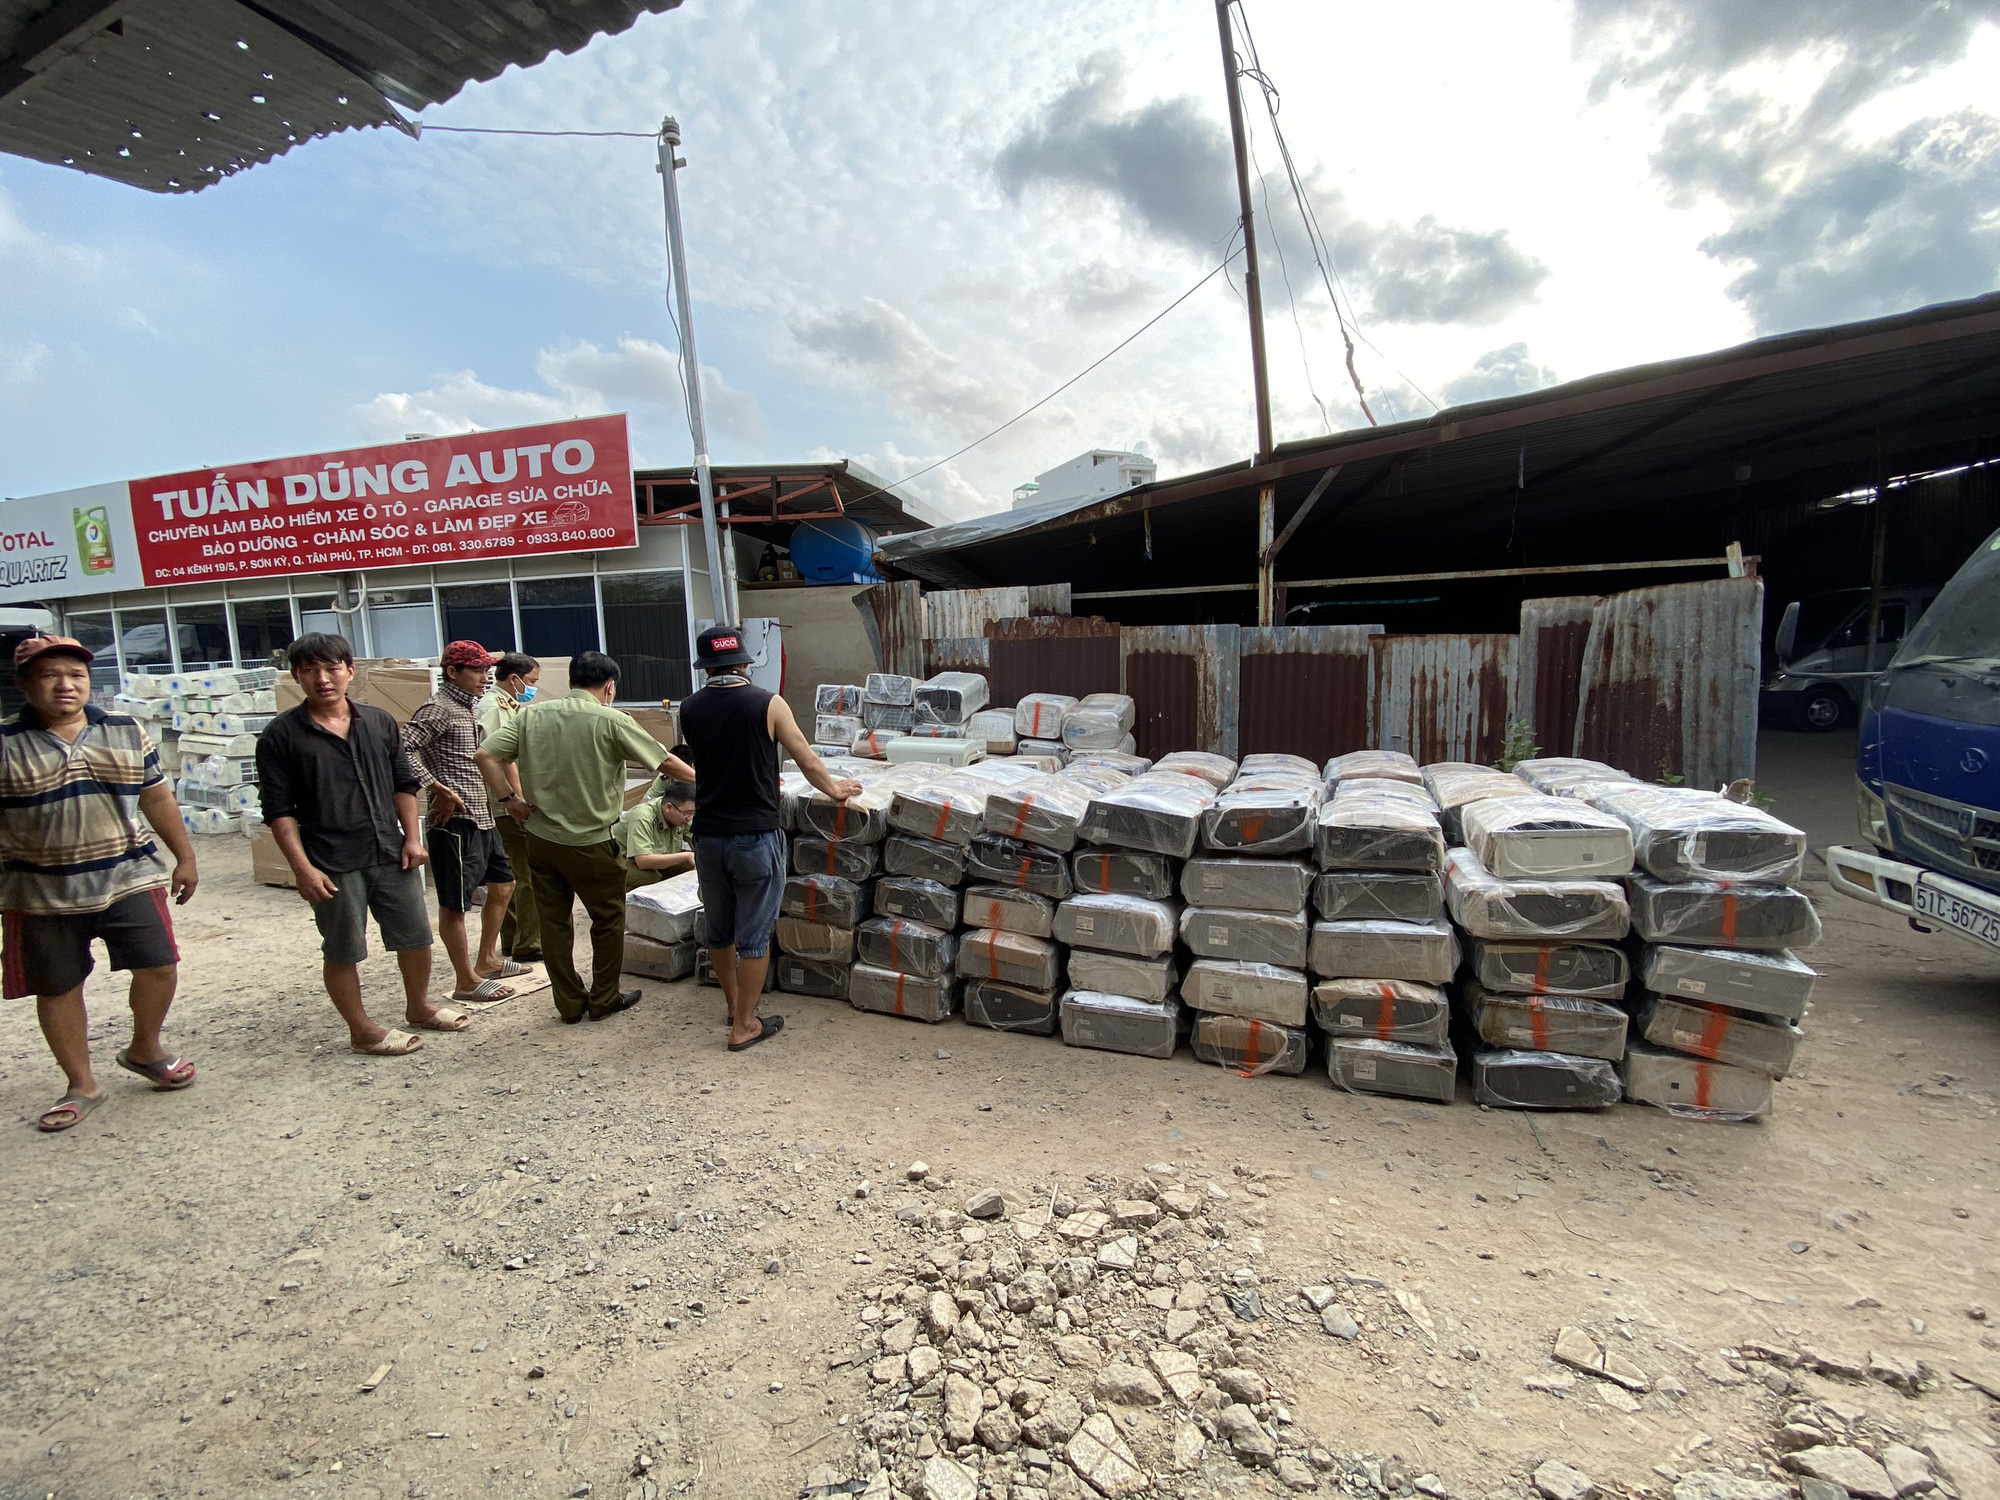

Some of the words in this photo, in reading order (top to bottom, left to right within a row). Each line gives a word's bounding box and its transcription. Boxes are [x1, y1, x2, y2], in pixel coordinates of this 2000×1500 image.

[153, 473, 270, 520] TUẤN
[283, 461, 430, 505] DŨNG
[445, 439, 595, 487] AUTO
[148, 524, 210, 543] CHUYÊN
[213, 520, 246, 536] LÀM
[289, 508, 332, 527] HIỂM
[336, 508, 359, 522] XE
[363, 503, 378, 519] Ô
[381, 500, 407, 517] TÔ
[424, 493, 503, 513] GARAGE
[507, 486, 548, 504] SỬA
[553, 479, 613, 500] CHỮA
[239, 535, 298, 553] DƯỠNG
[313, 527, 366, 545] CHĂM
[370, 523, 409, 540] SÓC
[414, 523, 428, 536] &
[432, 517, 473, 535] LÀM
[478, 514, 517, 531] ĐẸP
[522, 511, 548, 526] XE
[155, 568, 171, 578] ĐC:
[173, 566, 185, 576] 04
[187, 563, 213, 575] KÊNH
[214, 561, 238, 573] 19/5,
[239, 560, 248, 570] P.
[250, 557, 272, 569] SƠN
[273, 555, 290, 567] KỲ,
[292, 555, 304, 565] Q.
[306, 552, 327, 564] TÂN
[329, 549, 355, 562] PHÚ,
[357, 549, 373, 559] TP.
[375, 546, 403, 558] HCM
[412, 544, 430, 555] ĐT:
[432, 542, 456, 553] 081.
[459, 536, 515, 550] 330.6789
[526, 527, 616, 545] 0933.840.800
[713, 639, 737, 649] GUCCI
[1917, 888, 2000, 942] 51C-567.25
